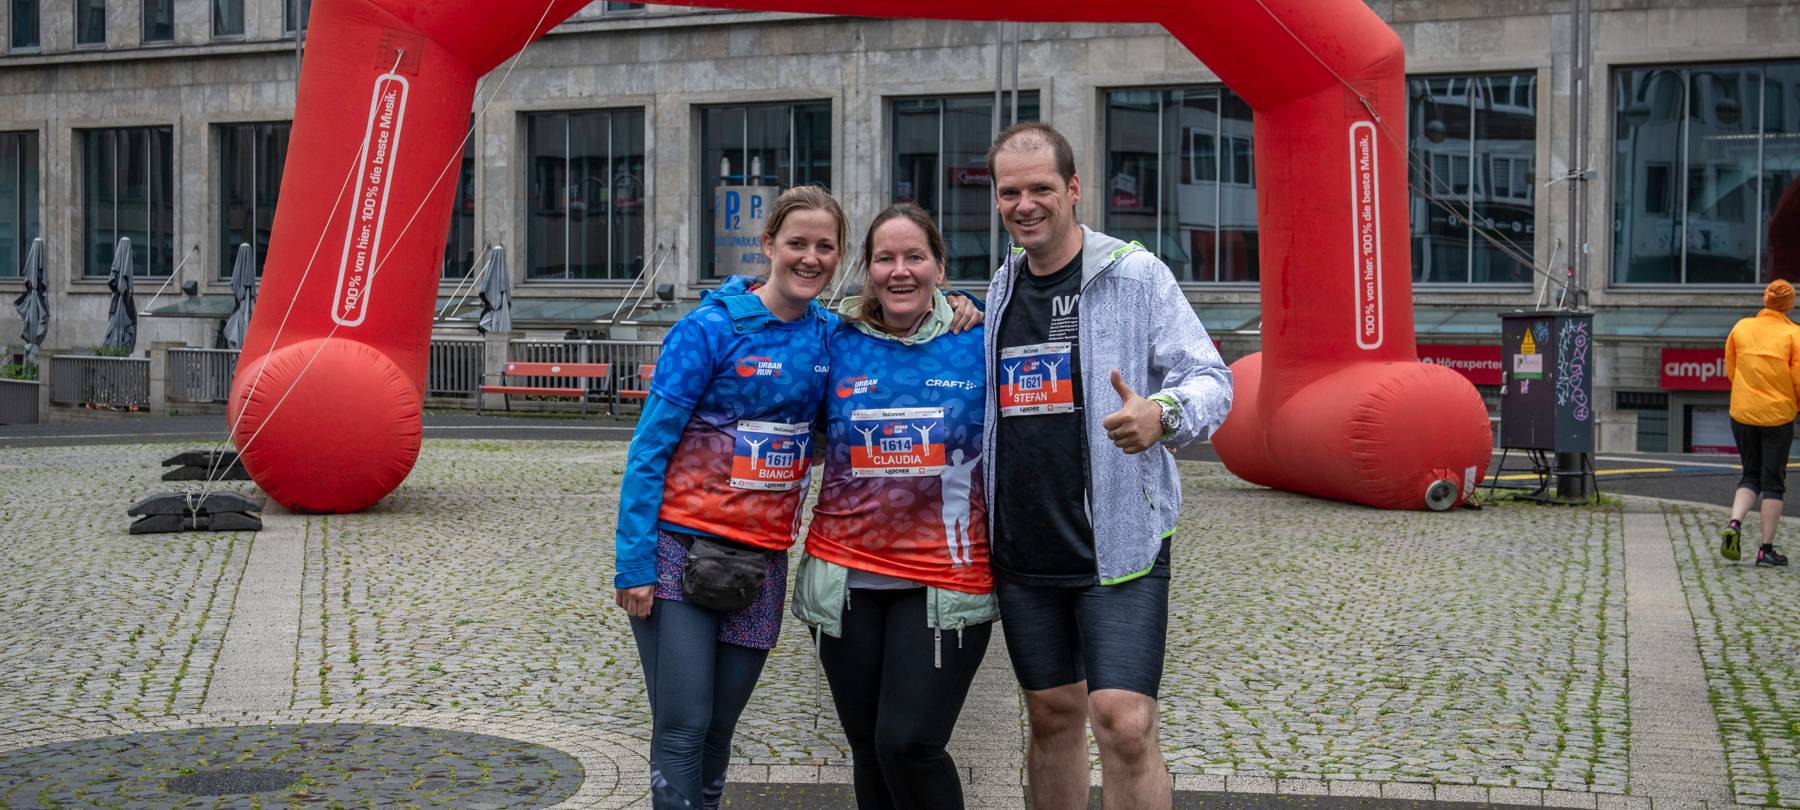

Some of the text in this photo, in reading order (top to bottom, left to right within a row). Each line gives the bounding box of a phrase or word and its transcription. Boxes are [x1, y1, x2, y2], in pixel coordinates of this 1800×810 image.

[345, 90, 397, 311] 100% von hier. 100% die beste Musik.
[1360, 135, 1375, 336] 100% von hier. 100% die beste Musik.
[854, 379, 878, 387] URBAN
[925, 379, 966, 388] CRAFT
[1021, 376, 1041, 389] 1621
[853, 387, 868, 395] RUN
[1014, 392, 1048, 402] STEFAN
[881, 440, 911, 451] 1614
[767, 454, 793, 466] 1611
[873, 455, 922, 465] CLAUDIA
[759, 469, 794, 478] BIANCA
